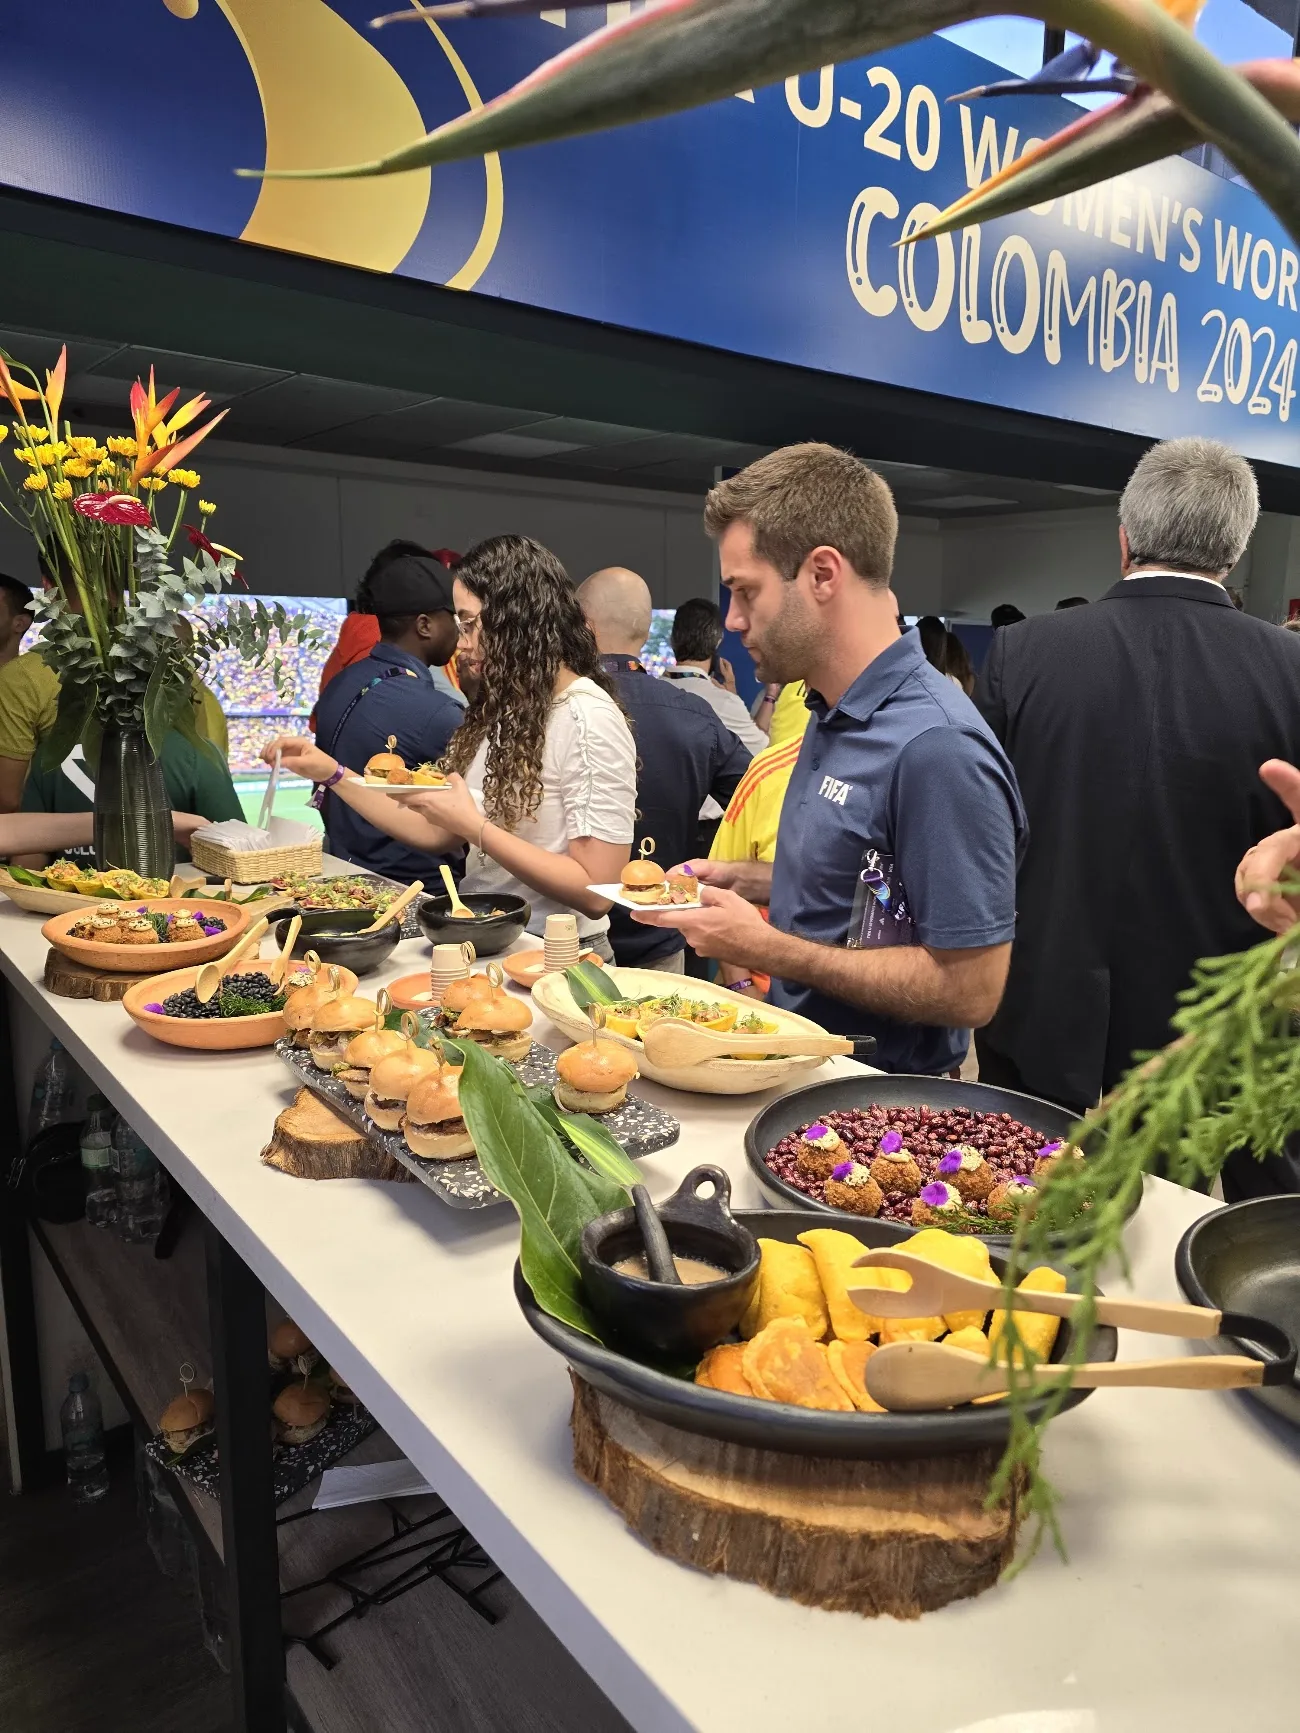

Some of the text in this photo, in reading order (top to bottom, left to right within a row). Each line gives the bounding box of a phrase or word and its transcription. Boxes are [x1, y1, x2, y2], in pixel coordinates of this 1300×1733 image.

[784, 64, 941, 172] U-20
[846, 186, 1298, 422] COLOMBIA 2024
[817, 775, 849, 806] FIFA
